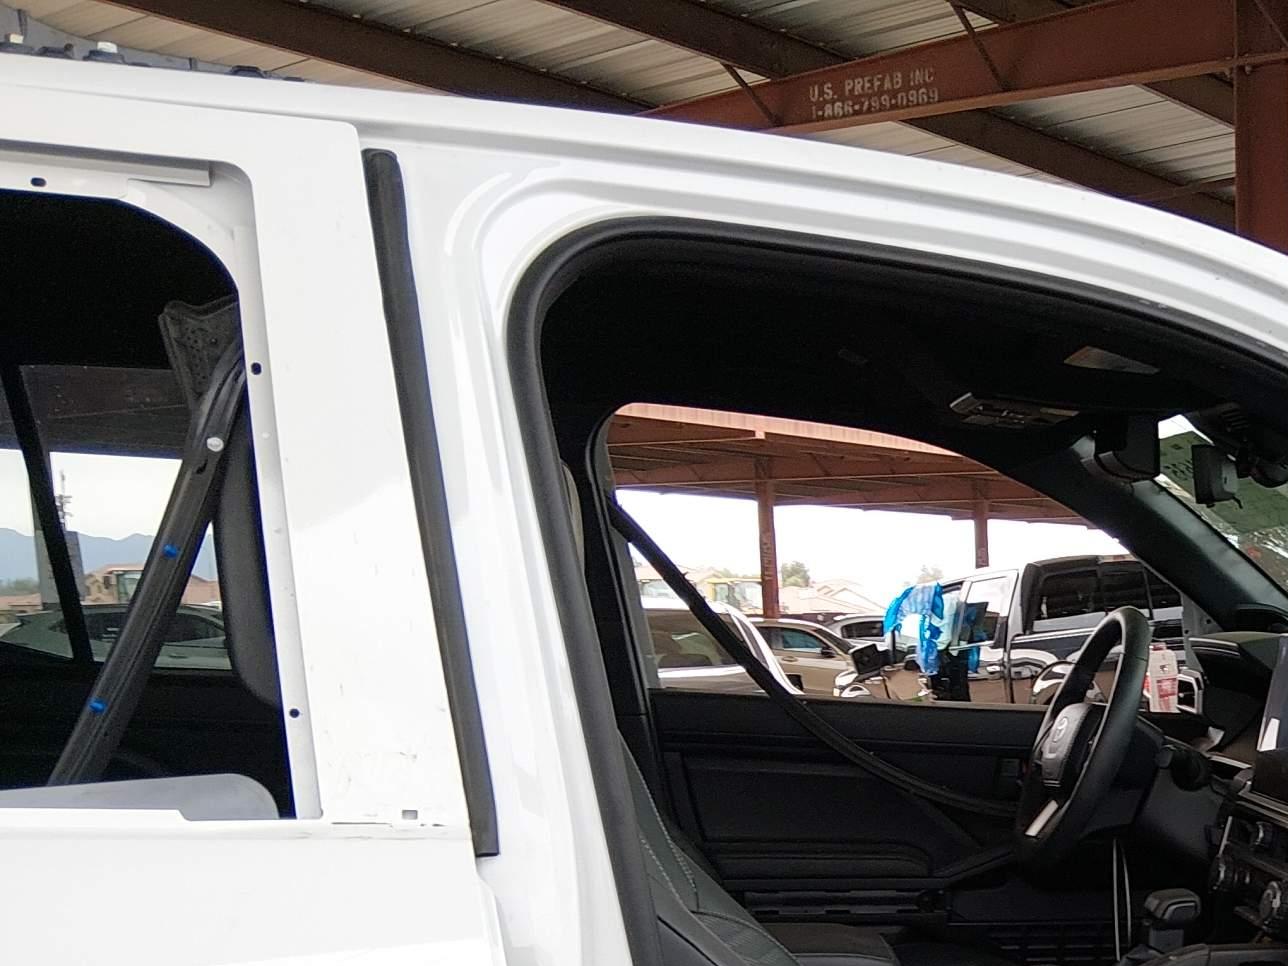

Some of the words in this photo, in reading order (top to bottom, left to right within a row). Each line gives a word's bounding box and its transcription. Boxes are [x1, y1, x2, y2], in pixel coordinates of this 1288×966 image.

[809, 82, 838, 102] U.S.
[844, 72, 902, 95] PREFAB
[811, 87, 939, 118] 1-866-799-0969
